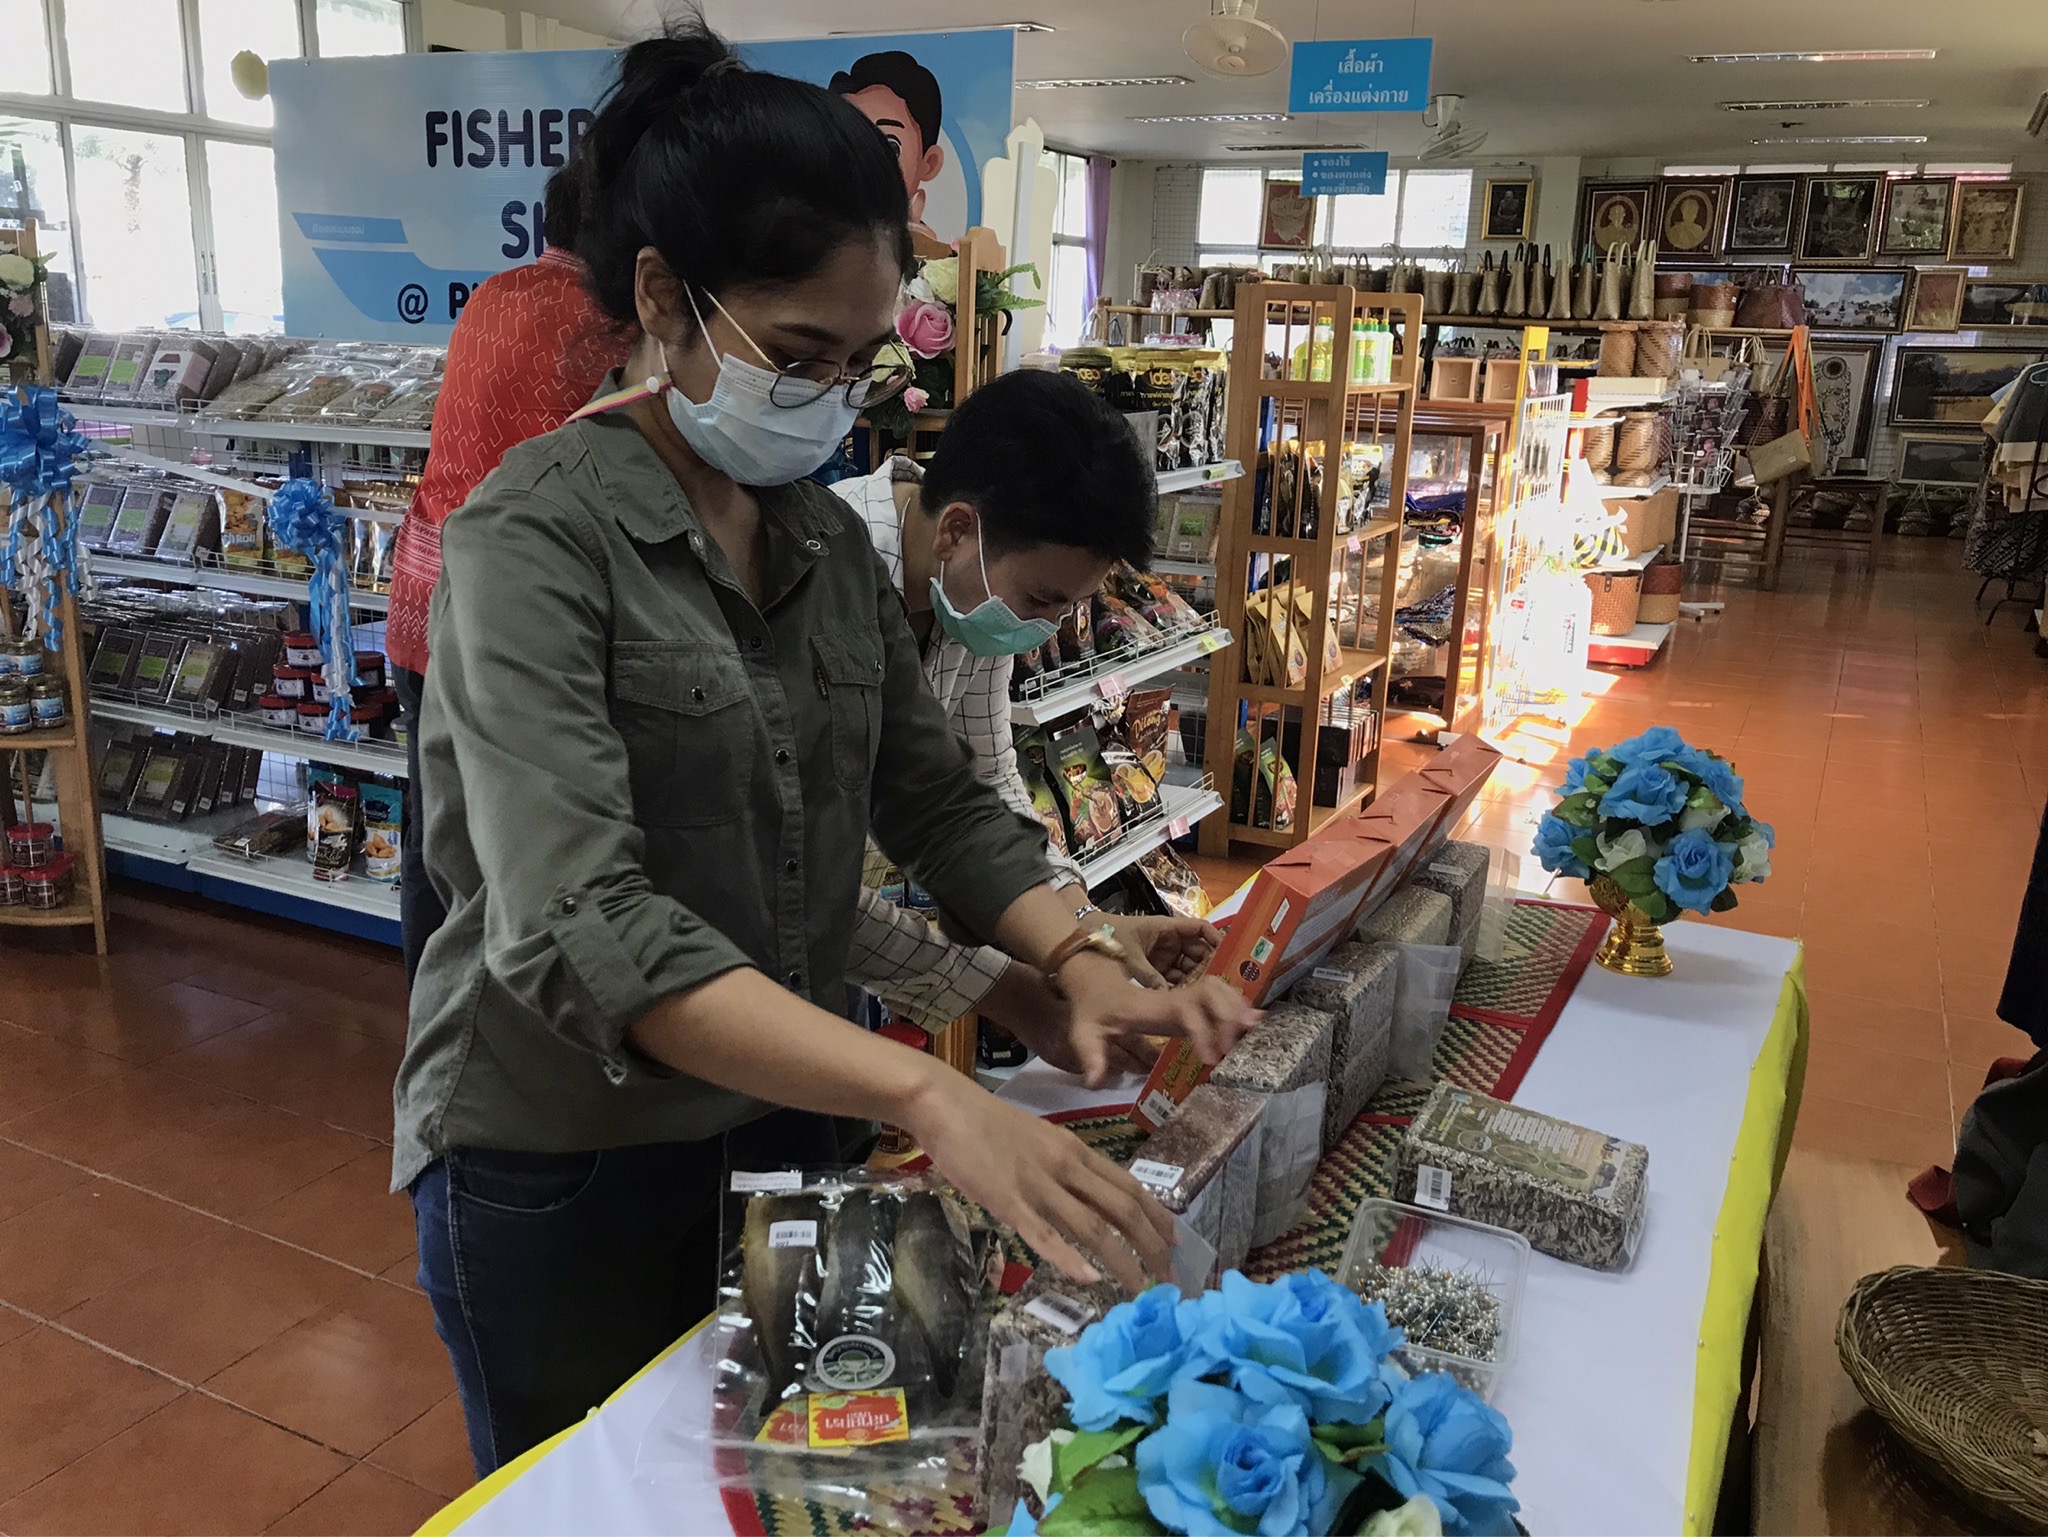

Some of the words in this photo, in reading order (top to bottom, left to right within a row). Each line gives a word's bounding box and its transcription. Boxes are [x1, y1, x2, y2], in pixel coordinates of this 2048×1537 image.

[1338, 48, 1384, 74] เสื้อผ้า
[1308, 79, 1409, 104] เครื่องแต่งกาย
[1320, 155, 1352, 167] ของใช้
[398, 283, 428, 324] @
[449, 282, 479, 320] P
